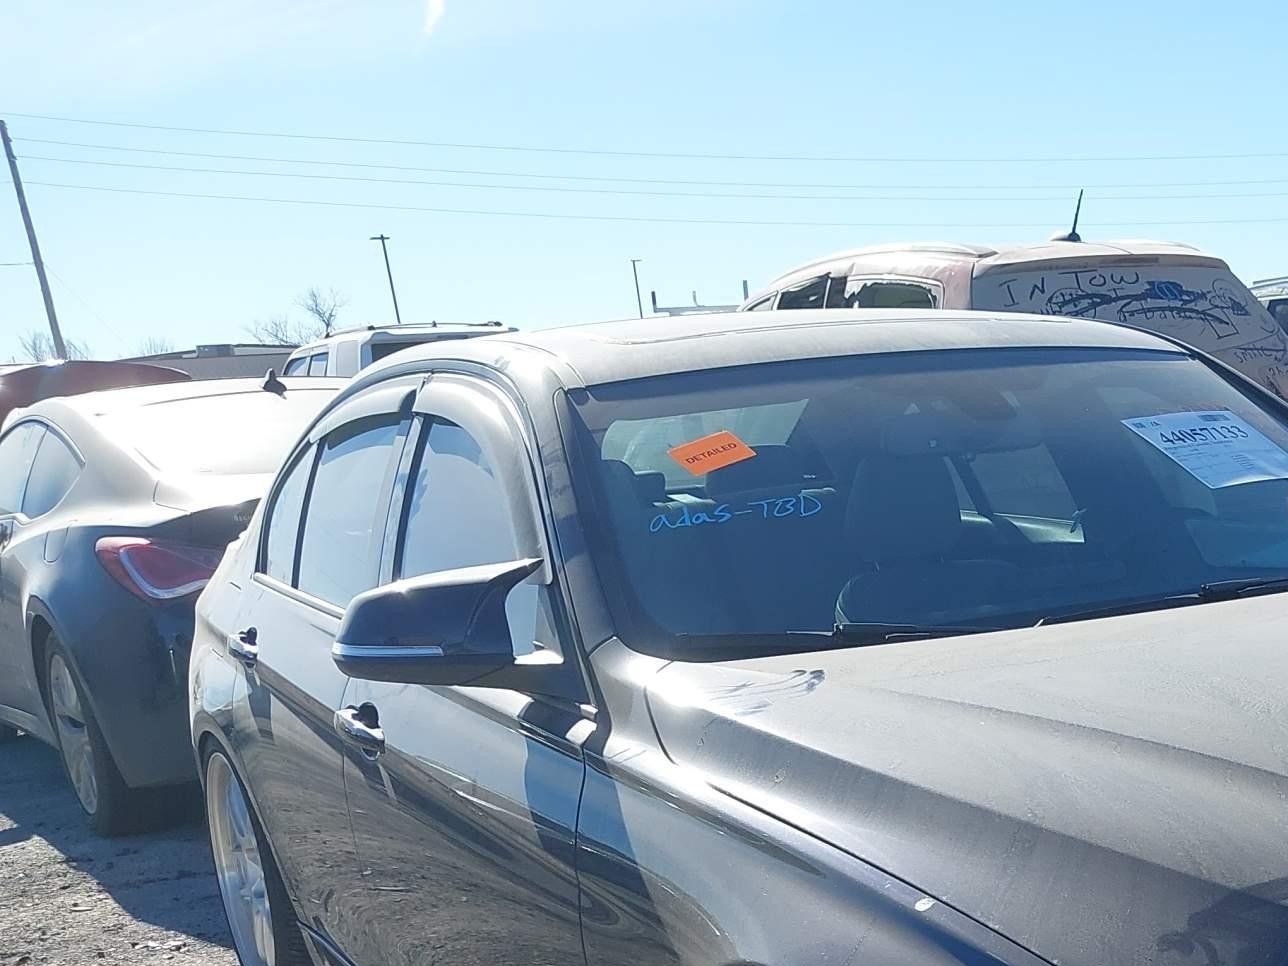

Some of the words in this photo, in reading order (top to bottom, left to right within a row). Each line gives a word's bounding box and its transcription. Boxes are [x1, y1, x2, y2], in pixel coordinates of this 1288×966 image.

[999, 276, 1046, 308] IN
[1159, 425, 1249, 445] 44057133
[685, 441, 738, 465] DETAILED
